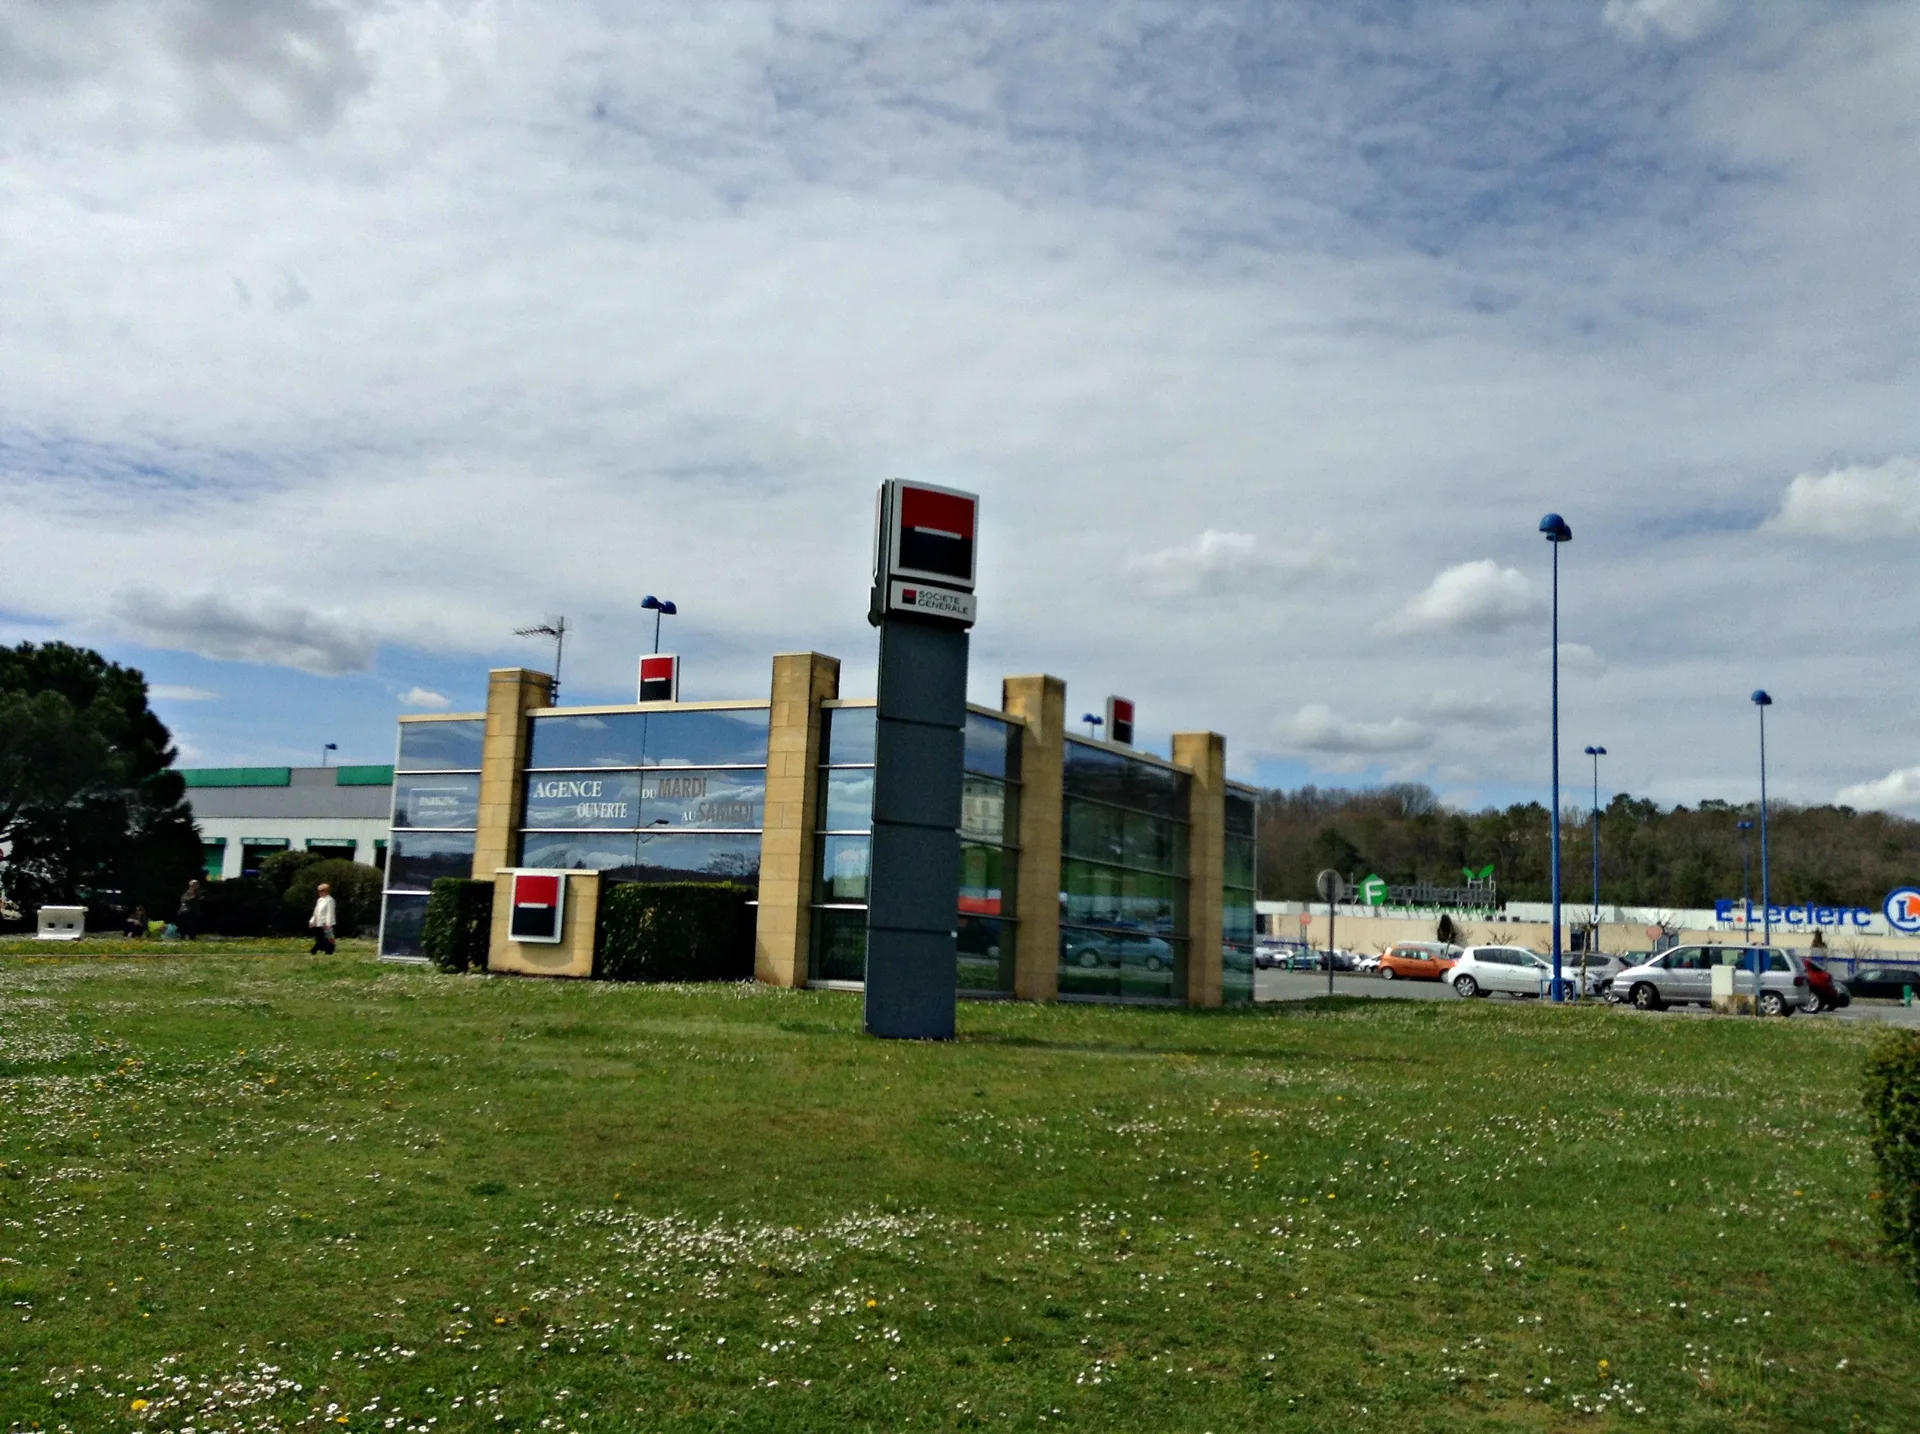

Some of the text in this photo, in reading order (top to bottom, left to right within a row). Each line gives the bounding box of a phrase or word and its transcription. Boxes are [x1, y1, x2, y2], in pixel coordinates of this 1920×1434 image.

[918, 590, 959, 604] SOCIETE
[918, 600, 968, 614] GENERALE
[533, 781, 602, 798] AGENCE
[641, 777, 707, 799] DU MARDI
[576, 802, 628, 818] OUVERTE
[681, 810, 696, 821] AU
